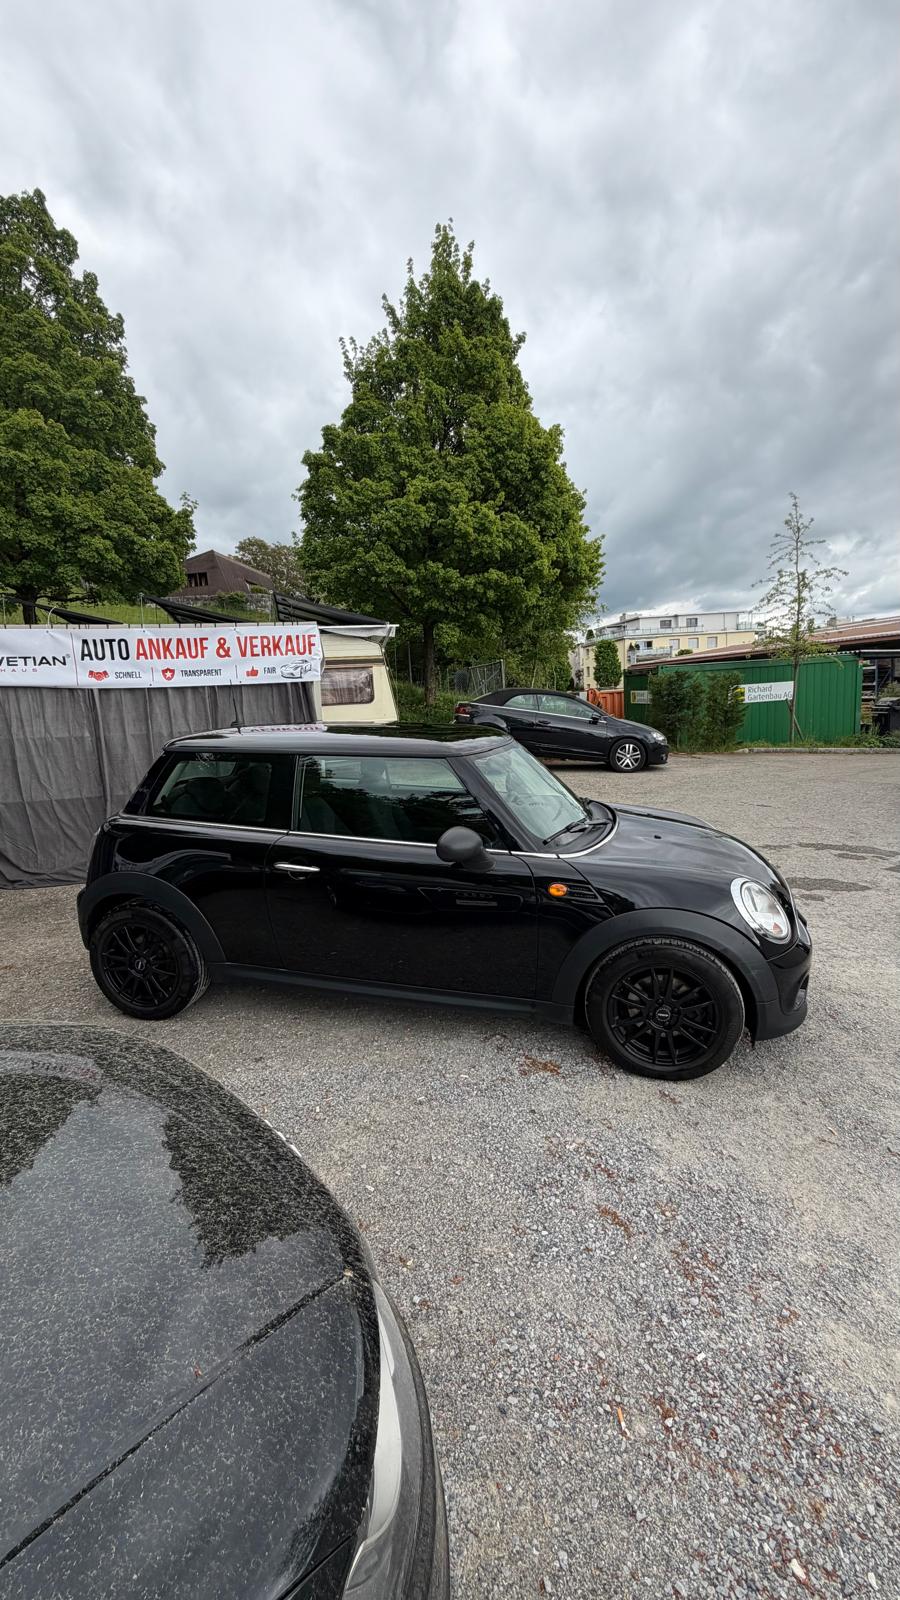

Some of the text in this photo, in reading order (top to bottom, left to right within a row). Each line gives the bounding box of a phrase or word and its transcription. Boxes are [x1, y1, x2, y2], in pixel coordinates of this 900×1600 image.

[80, 634, 316, 661] AUTO ANKAUF & VERKAUF
[180, 668, 222, 677] TRANSPARENT
[263, 666, 277, 674] FAIR
[115, 671, 142, 679] SCHNELL
[747, 684, 773, 693] Richard
[747, 690, 793, 701] Gartenbau AG
